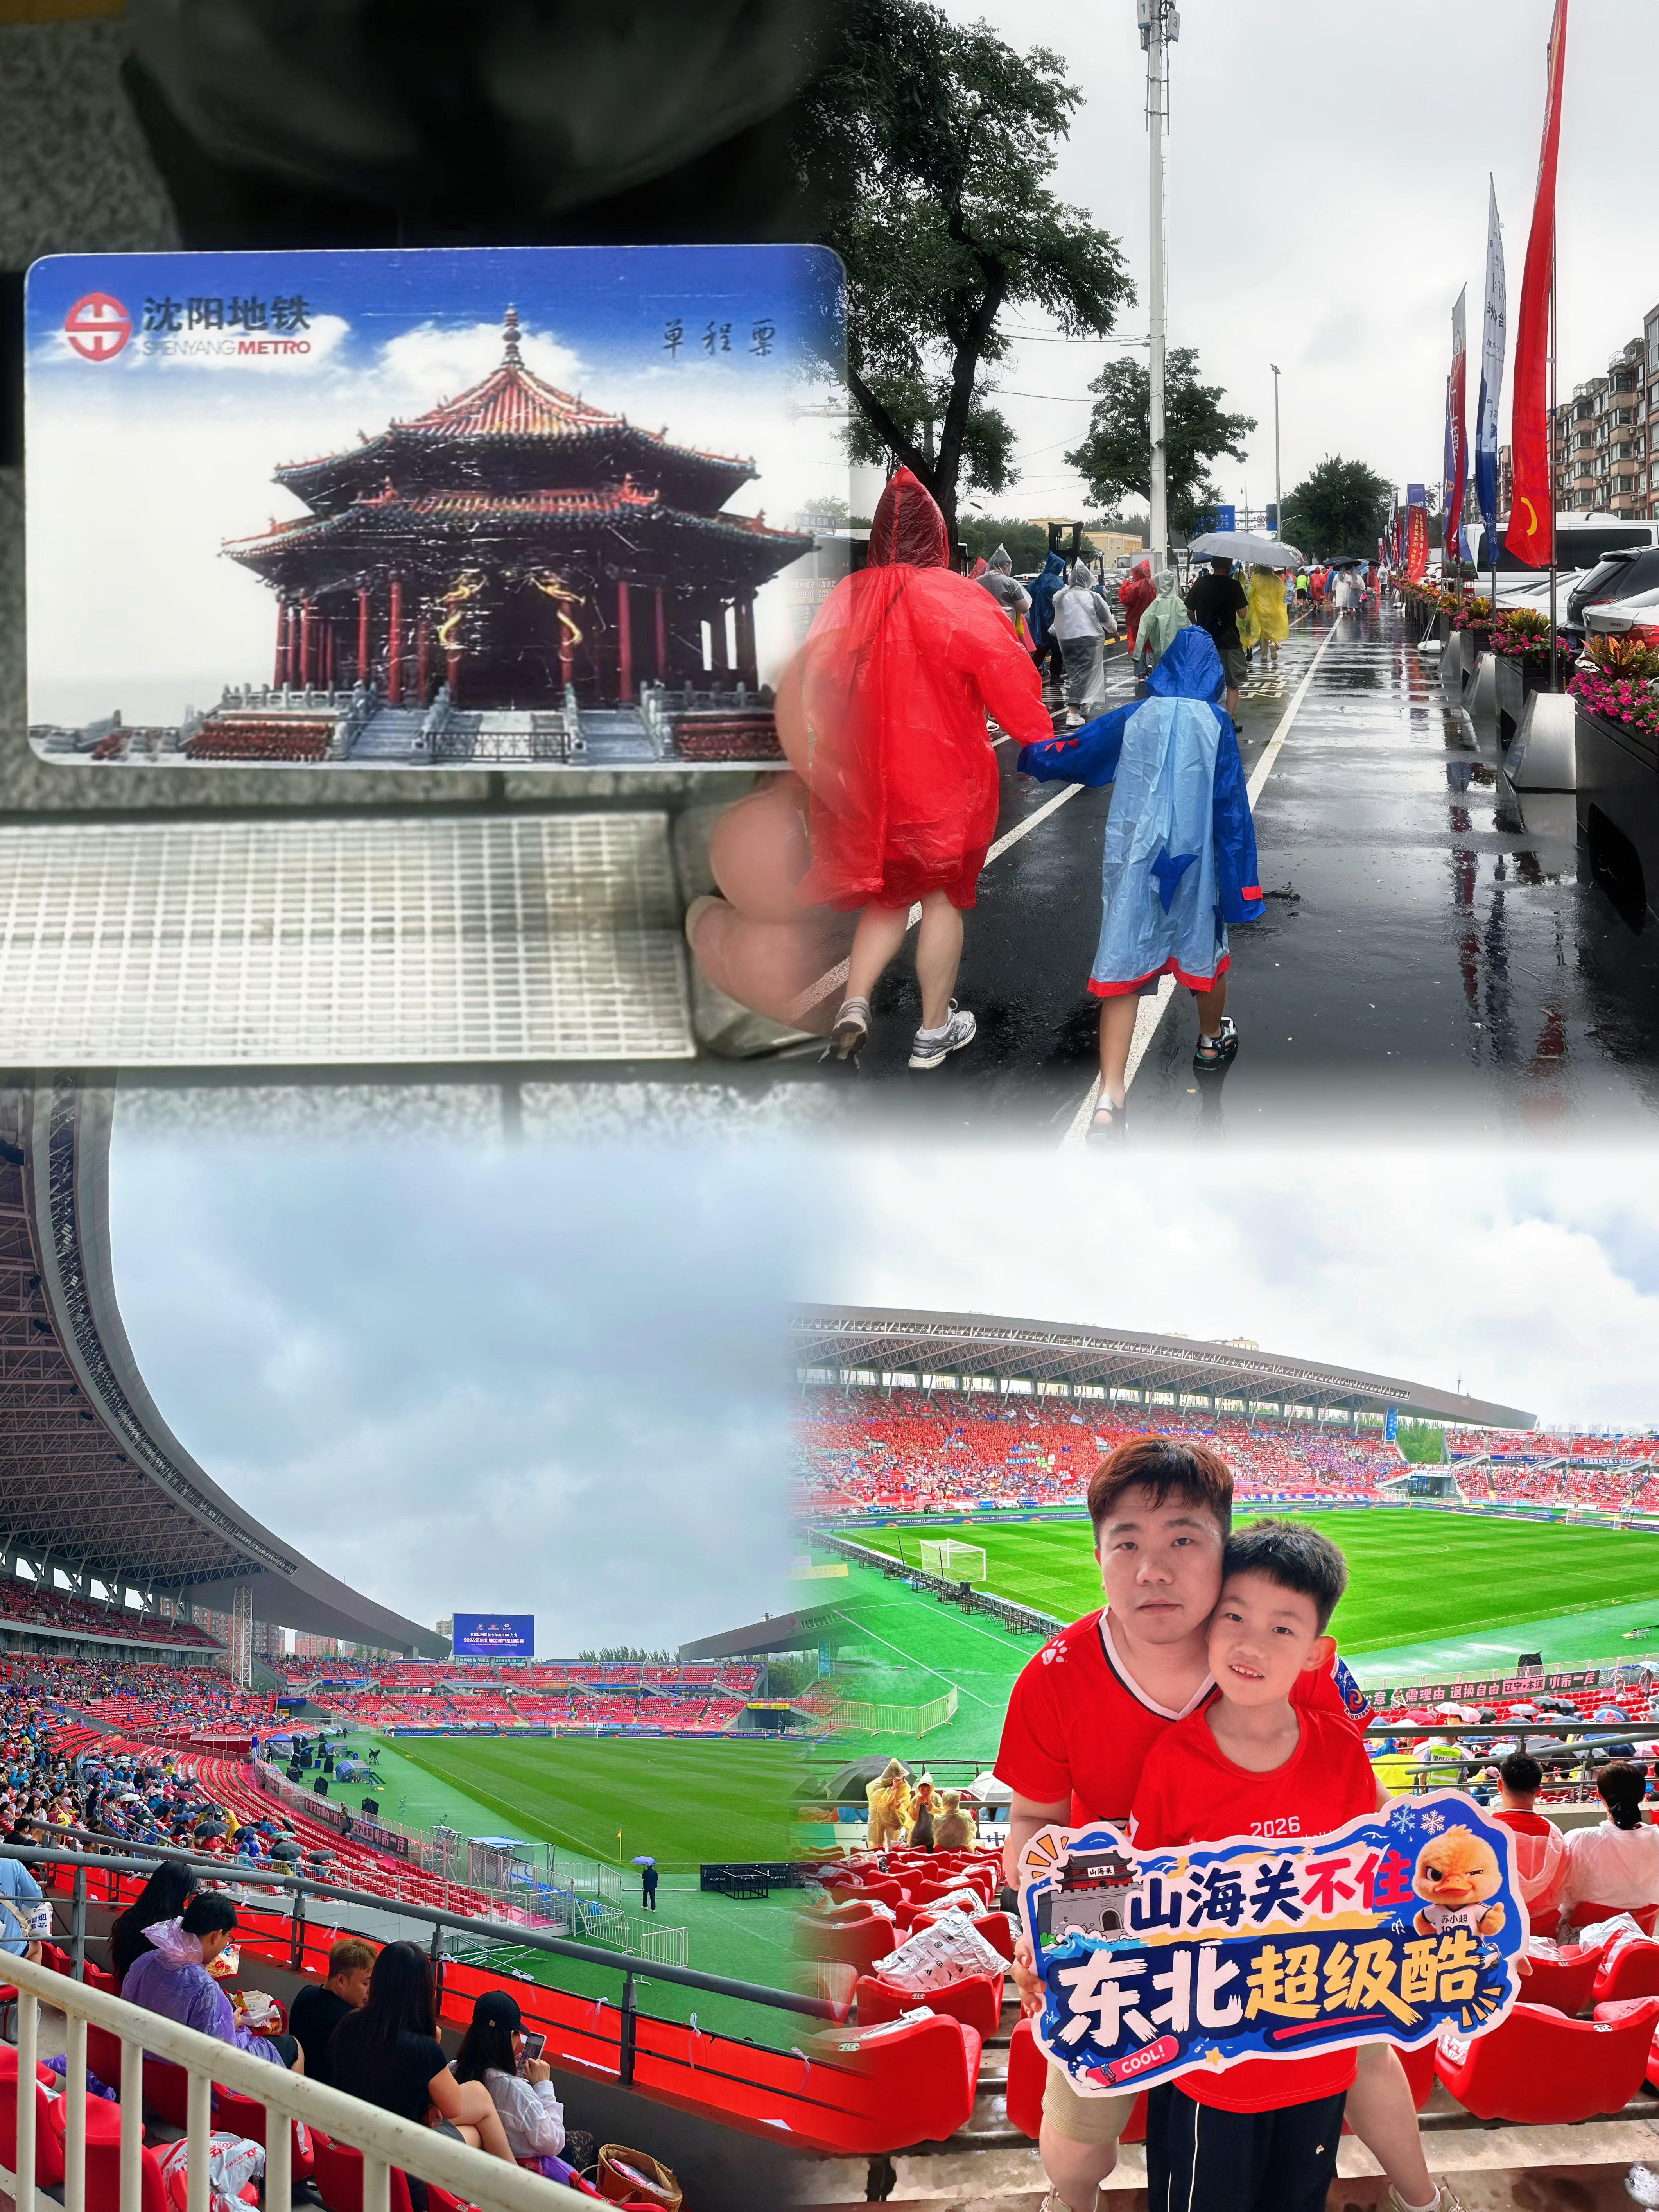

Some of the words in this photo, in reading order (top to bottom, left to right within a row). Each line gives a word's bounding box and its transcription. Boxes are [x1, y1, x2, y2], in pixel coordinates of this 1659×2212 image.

[143, 295, 311, 332] 沈阳地铁
[662, 318, 775, 359] 单程票
[143, 340, 235, 355] SHENYANG
[238, 340, 311, 355] METRO
[1450, 1682, 1500, 1698] 退换自由
[1549, 1672, 1595, 1689] 小市一庄
[1250, 1816, 1300, 1837] 2026
[375, 1828, 405, 1853] 小市一庄
[1130, 1849, 1414, 1931] 山海关不住
[1441, 1914, 1468, 1923] 苏小超
[935, 1958, 943, 1968] UGG
[1058, 1930, 1480, 2047] 东北超级酷
[1122, 2044, 1165, 2074] COOL!
[243, 2146, 258, 2158] JDL
